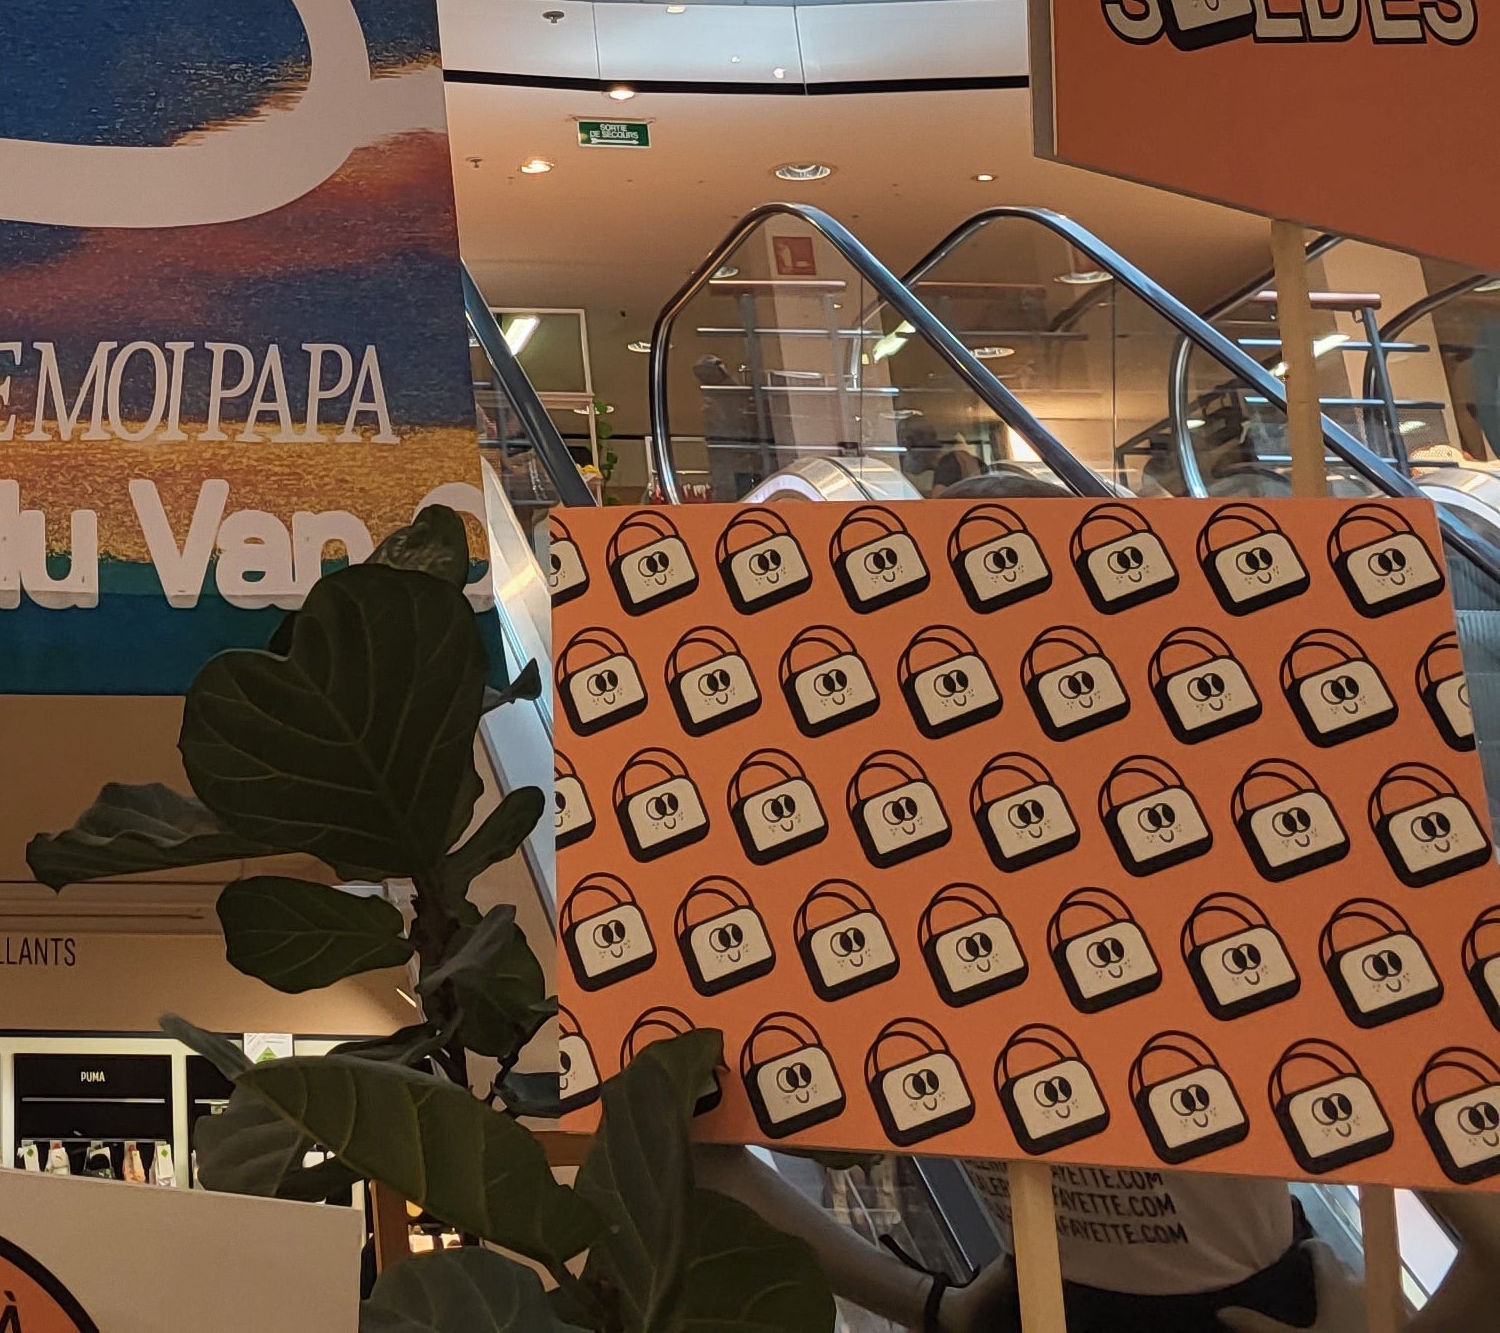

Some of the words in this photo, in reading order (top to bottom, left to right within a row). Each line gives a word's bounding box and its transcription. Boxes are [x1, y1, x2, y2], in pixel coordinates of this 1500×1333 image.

[599, 123, 628, 132] SORTIE
[601, 130, 639, 139] SECOURS
[128, 478, 375, 610] Van
[80, 1071, 106, 1083] PUMA
